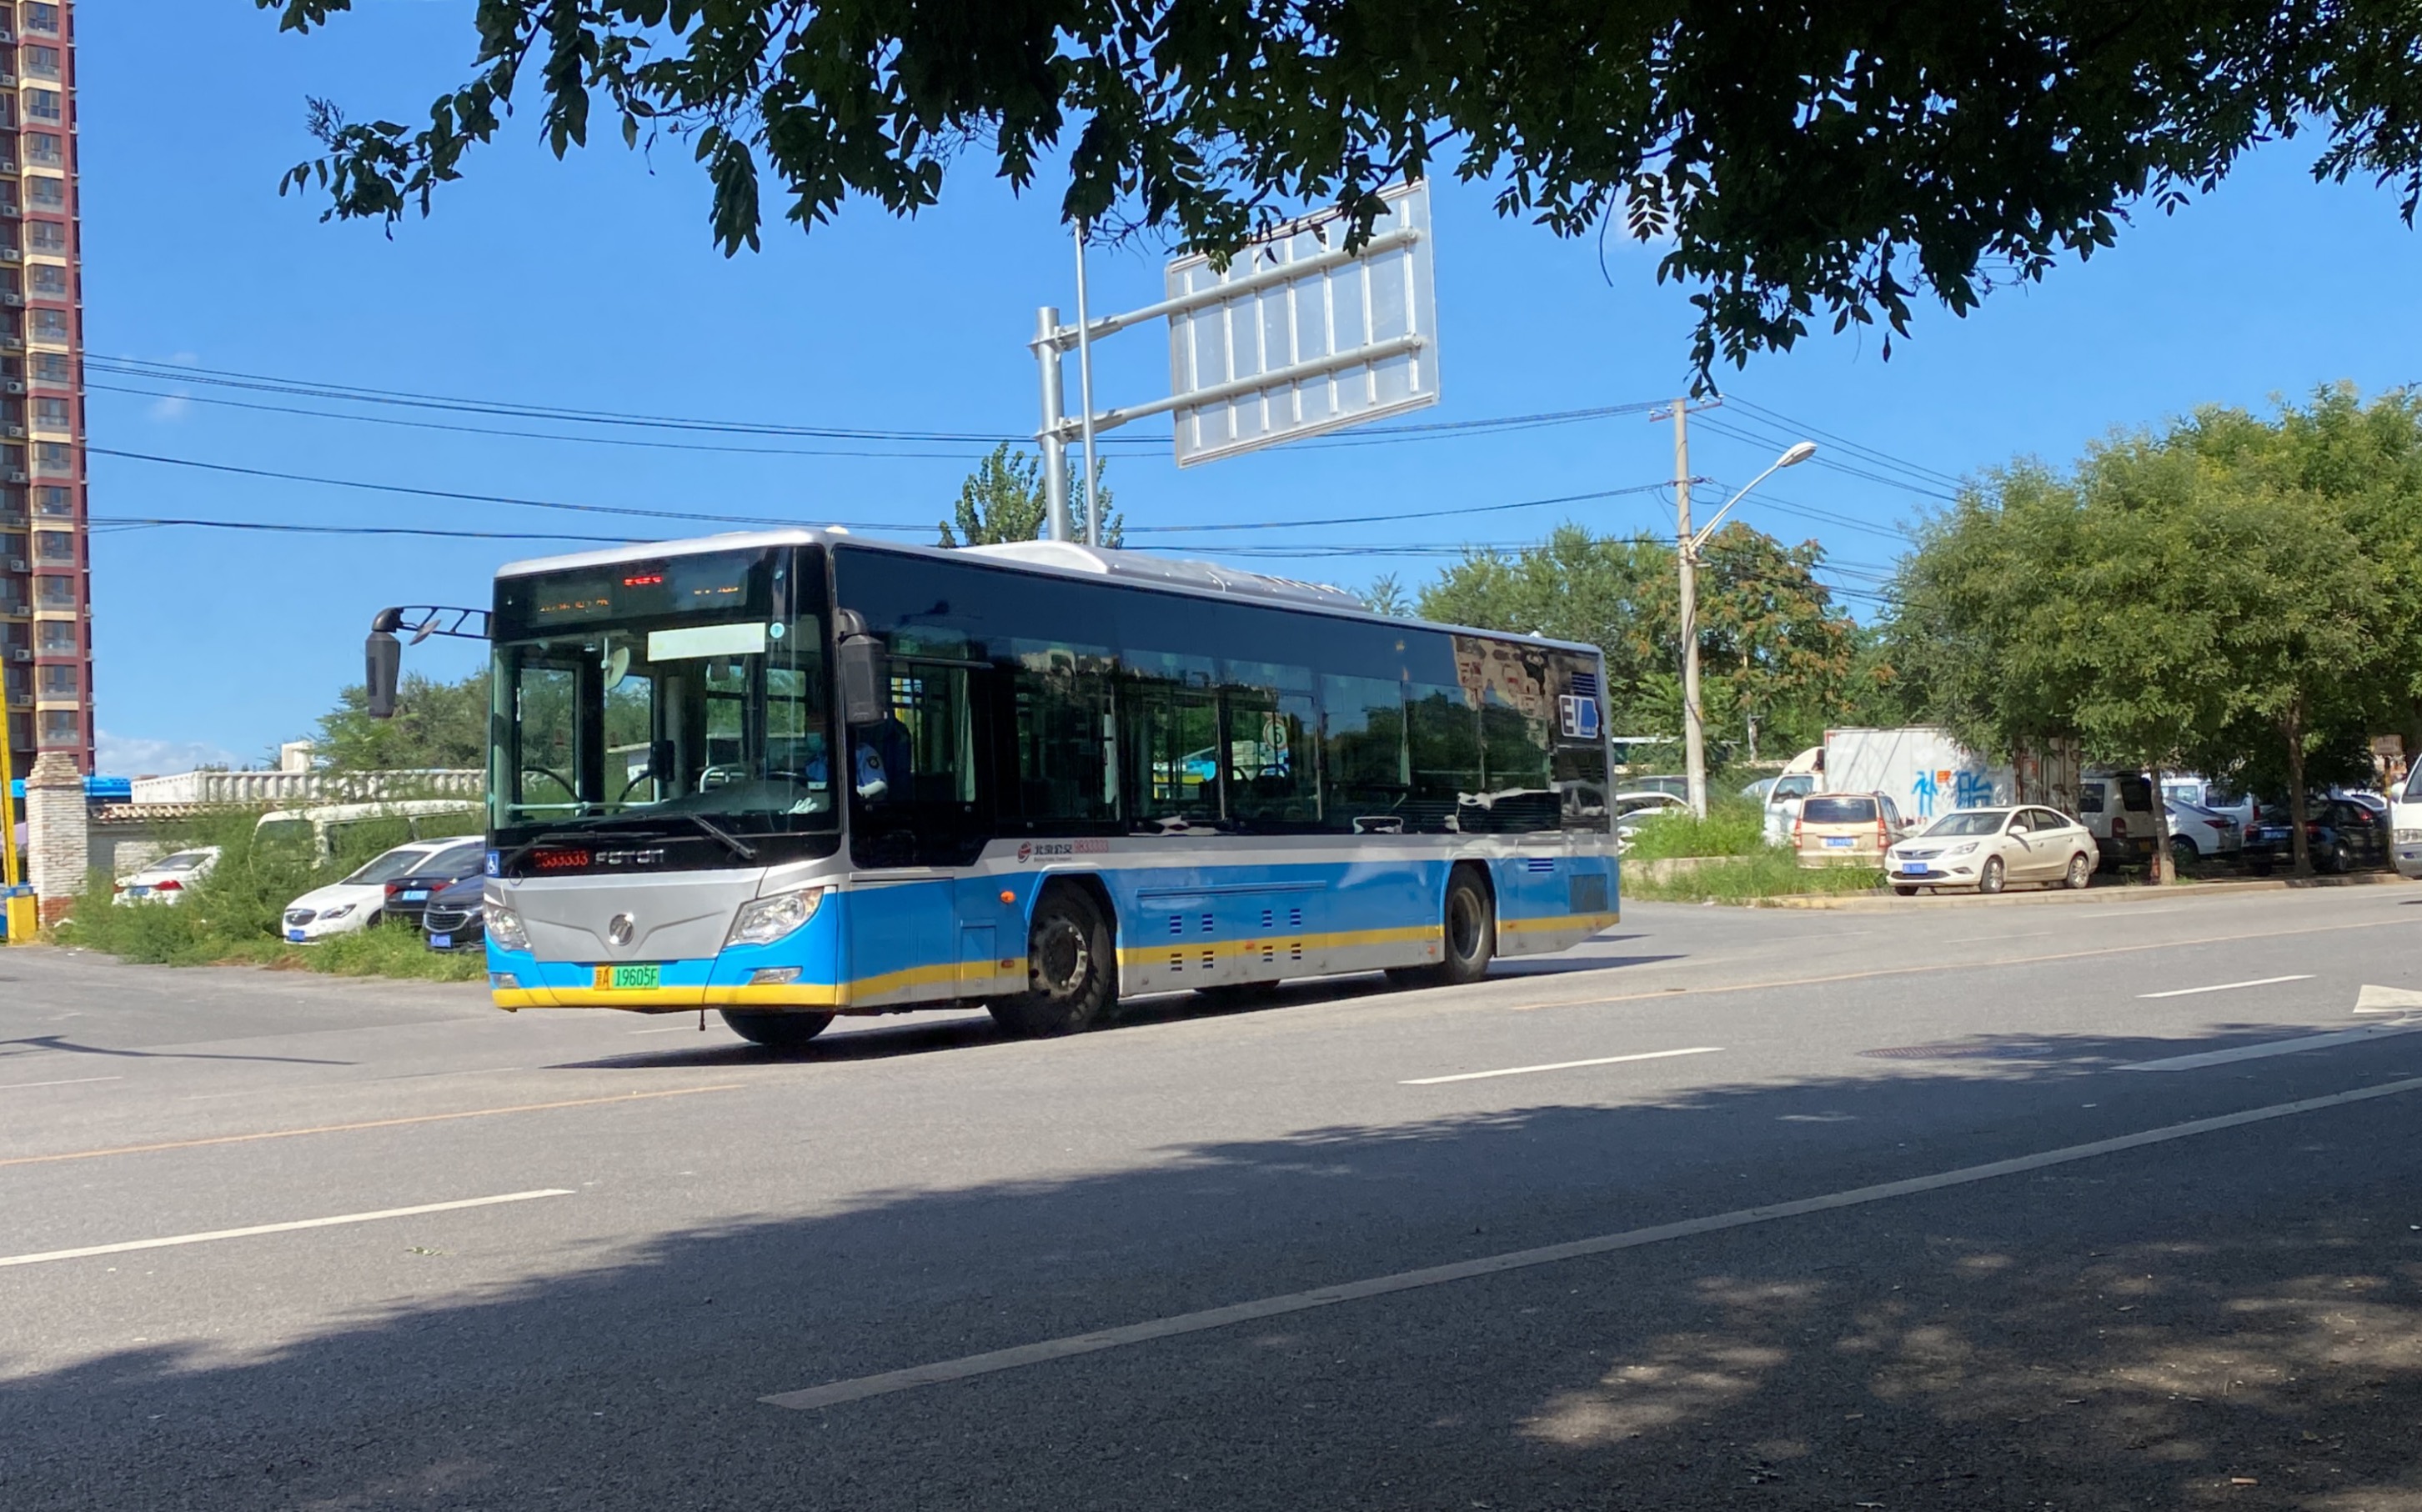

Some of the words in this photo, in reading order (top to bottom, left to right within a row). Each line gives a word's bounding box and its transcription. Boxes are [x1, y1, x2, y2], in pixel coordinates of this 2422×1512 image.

[1034, 844, 1072, 855] 北京公交
[615, 969, 658, 987] 19605F
